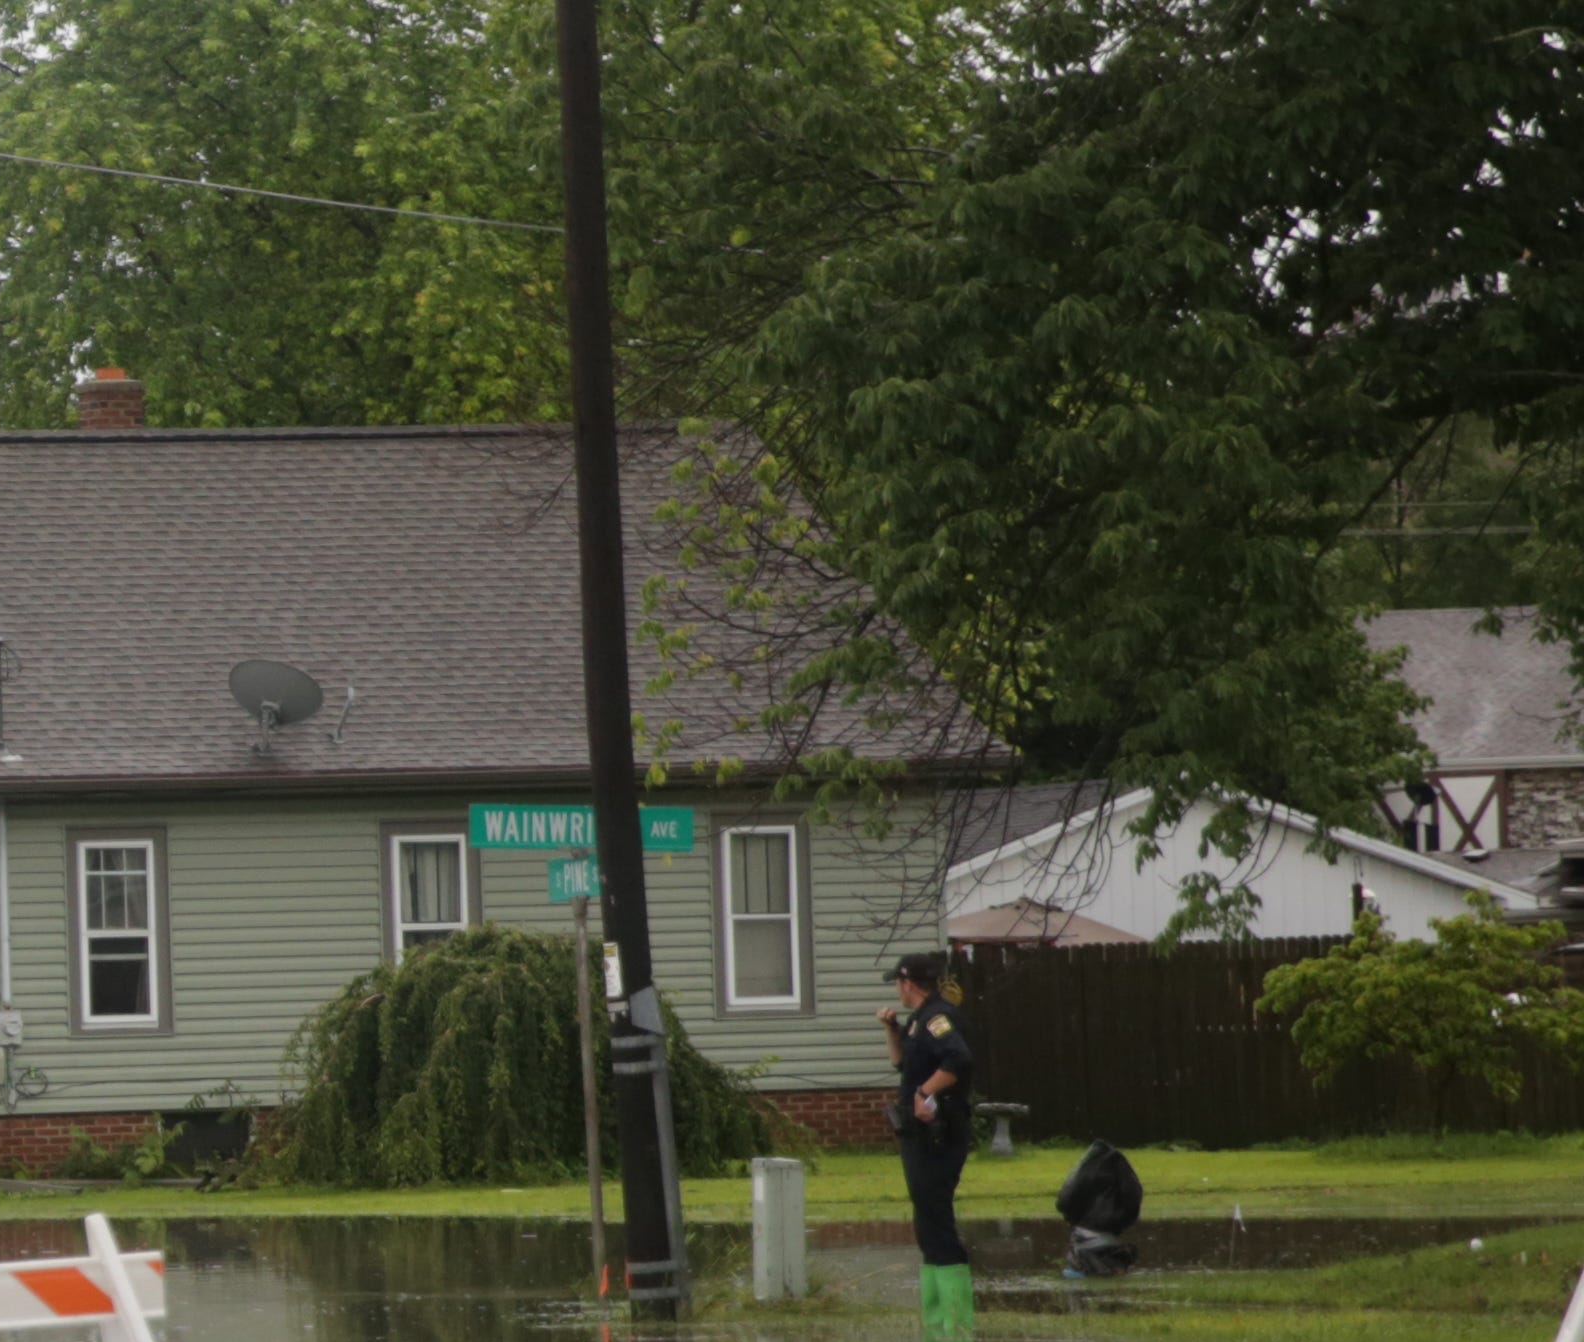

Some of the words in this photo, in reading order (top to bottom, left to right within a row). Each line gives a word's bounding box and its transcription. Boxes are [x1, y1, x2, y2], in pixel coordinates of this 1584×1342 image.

[484, 811, 593, 843] WAINWRI
[650, 821, 677, 838] AVE
[564, 860, 590, 893] PINE
